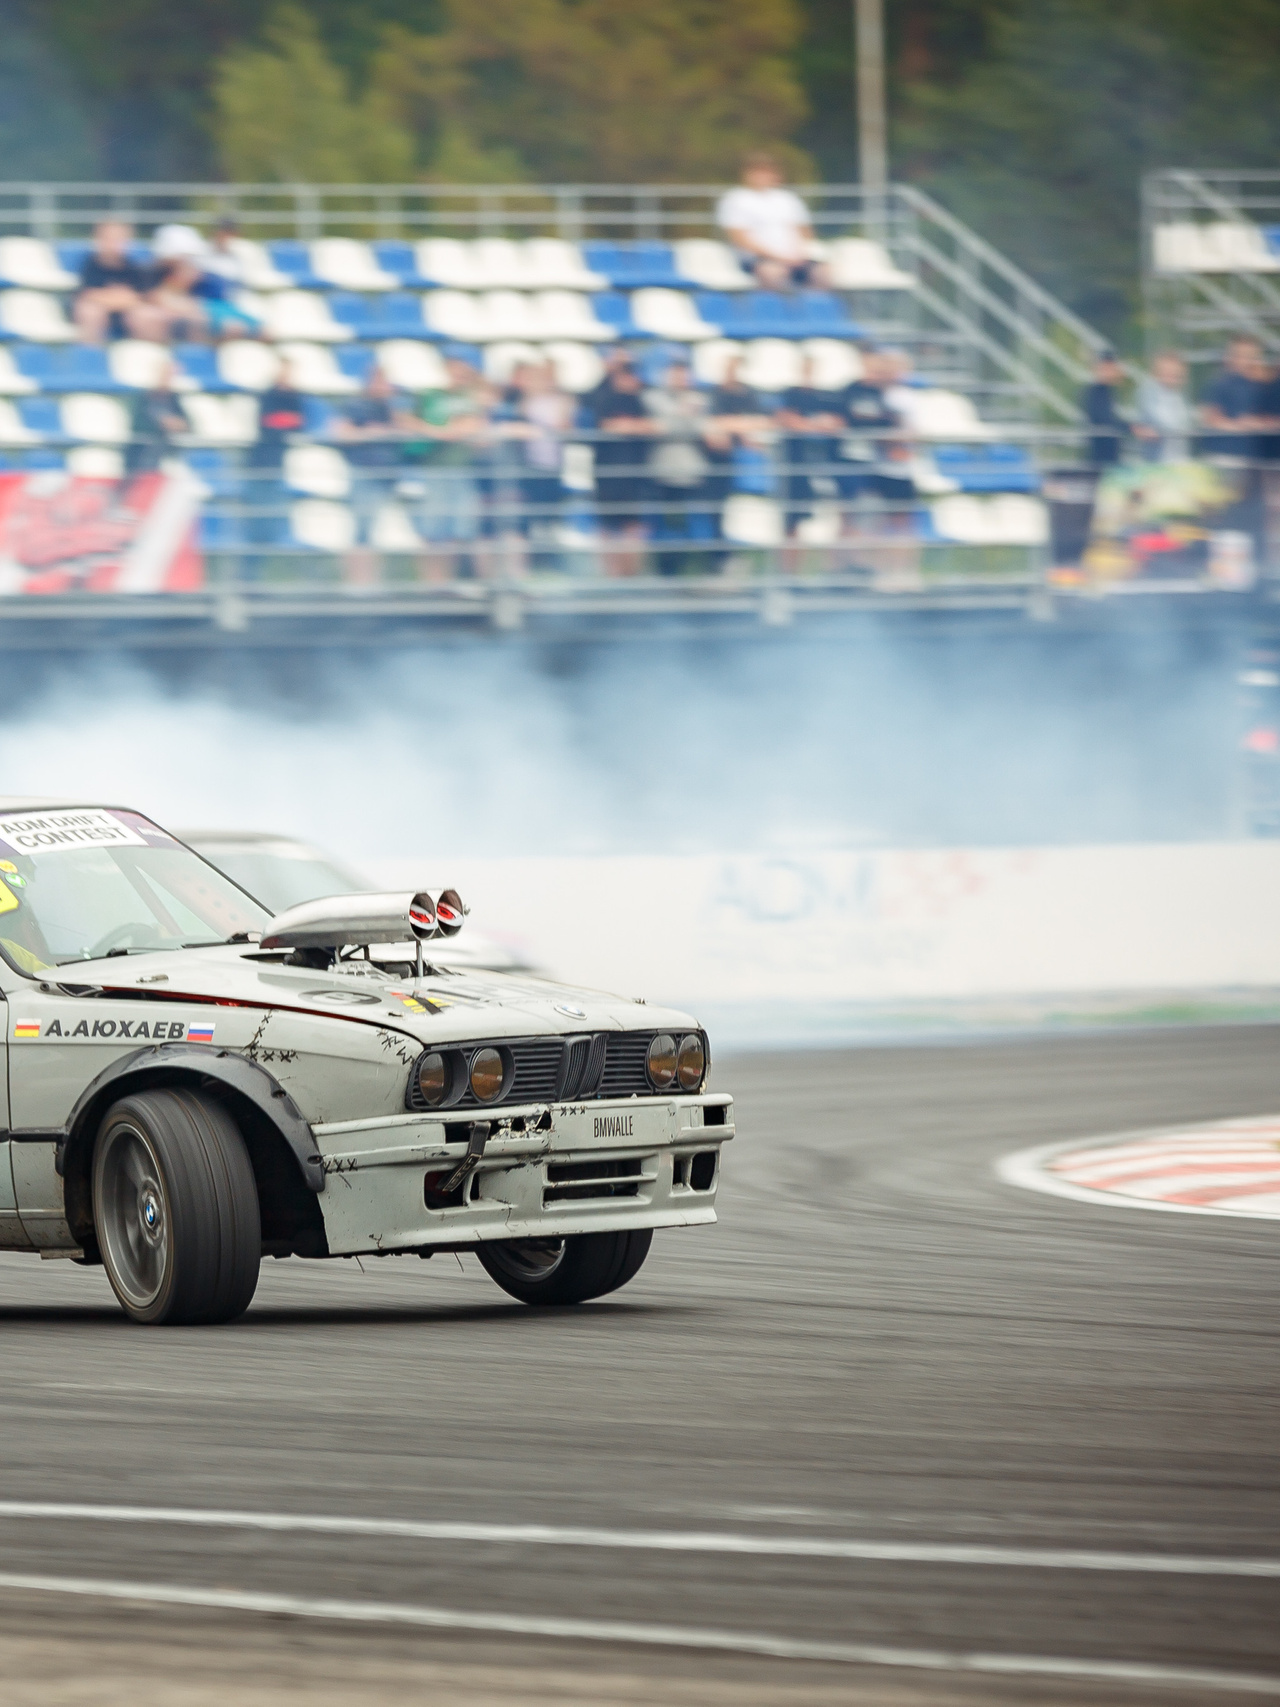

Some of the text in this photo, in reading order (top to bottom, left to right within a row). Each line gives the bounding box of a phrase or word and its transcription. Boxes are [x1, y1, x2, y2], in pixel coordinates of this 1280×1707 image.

[0, 814, 110, 835] ADM DRIFT
[15, 826, 128, 848] CONTEST
[45, 1019, 185, 1039] А.АЮХАЕВ
[593, 1115, 634, 1138] BMWALLE
